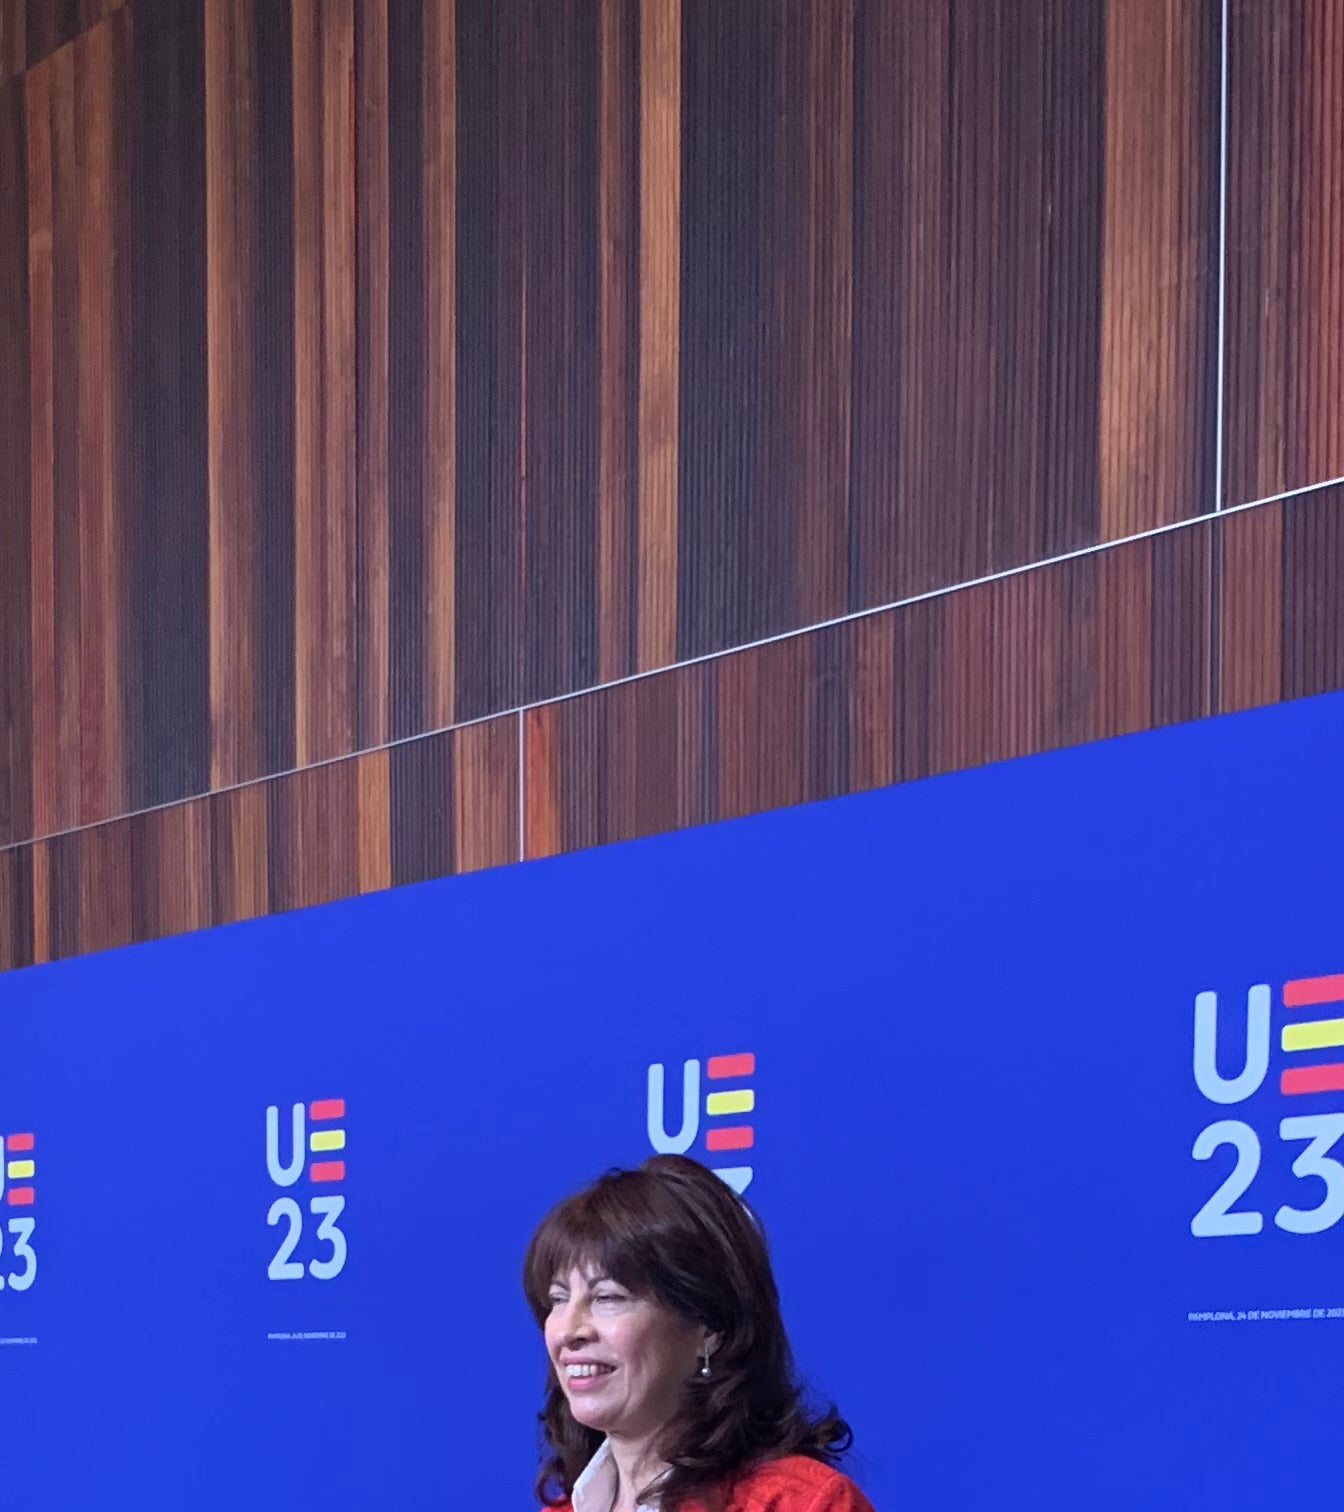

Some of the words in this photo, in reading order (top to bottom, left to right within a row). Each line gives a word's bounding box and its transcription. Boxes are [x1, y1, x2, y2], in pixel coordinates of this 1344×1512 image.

[266, 1098, 346, 1187] UE
[647, 1052, 756, 1155] UE
[267, 1195, 347, 1280] 23
[1187, 1311, 1236, 1322] PAMPLONA,
[1247, 1310, 1260, 1321] DE
[1260, 1308, 1312, 1320] NOVIEMBRE
[1312, 1308, 1326, 1319] DE
